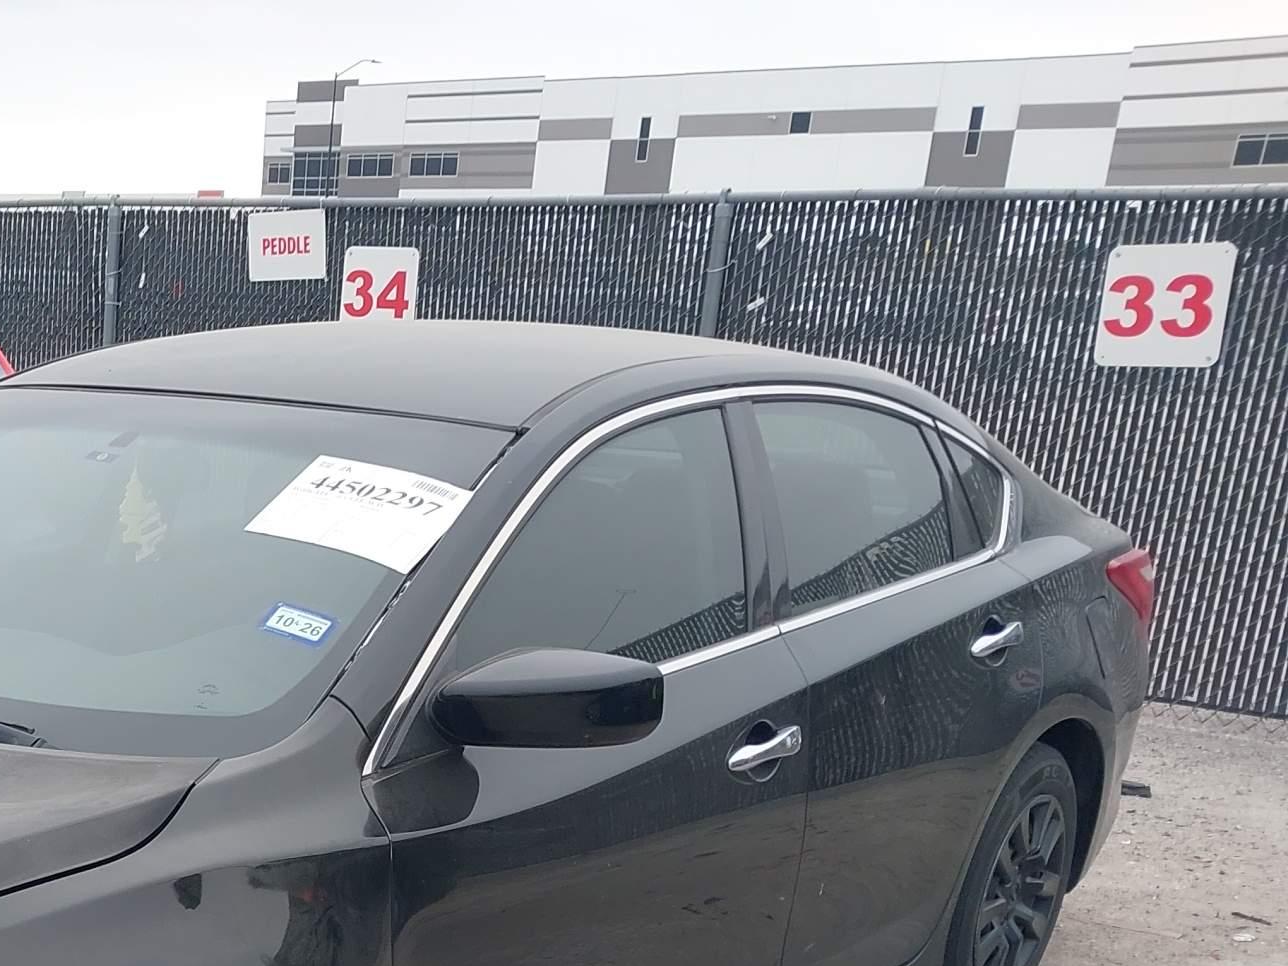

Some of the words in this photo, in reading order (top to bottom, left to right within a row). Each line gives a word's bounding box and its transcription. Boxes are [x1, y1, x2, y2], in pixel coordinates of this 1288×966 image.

[262, 235, 311, 256] PEDDLE
[343, 269, 410, 319] 34
[1103, 274, 1214, 338] 33
[310, 475, 444, 517] 44502297
[275, 614, 295, 628] 10
[298, 622, 323, 637] 26
